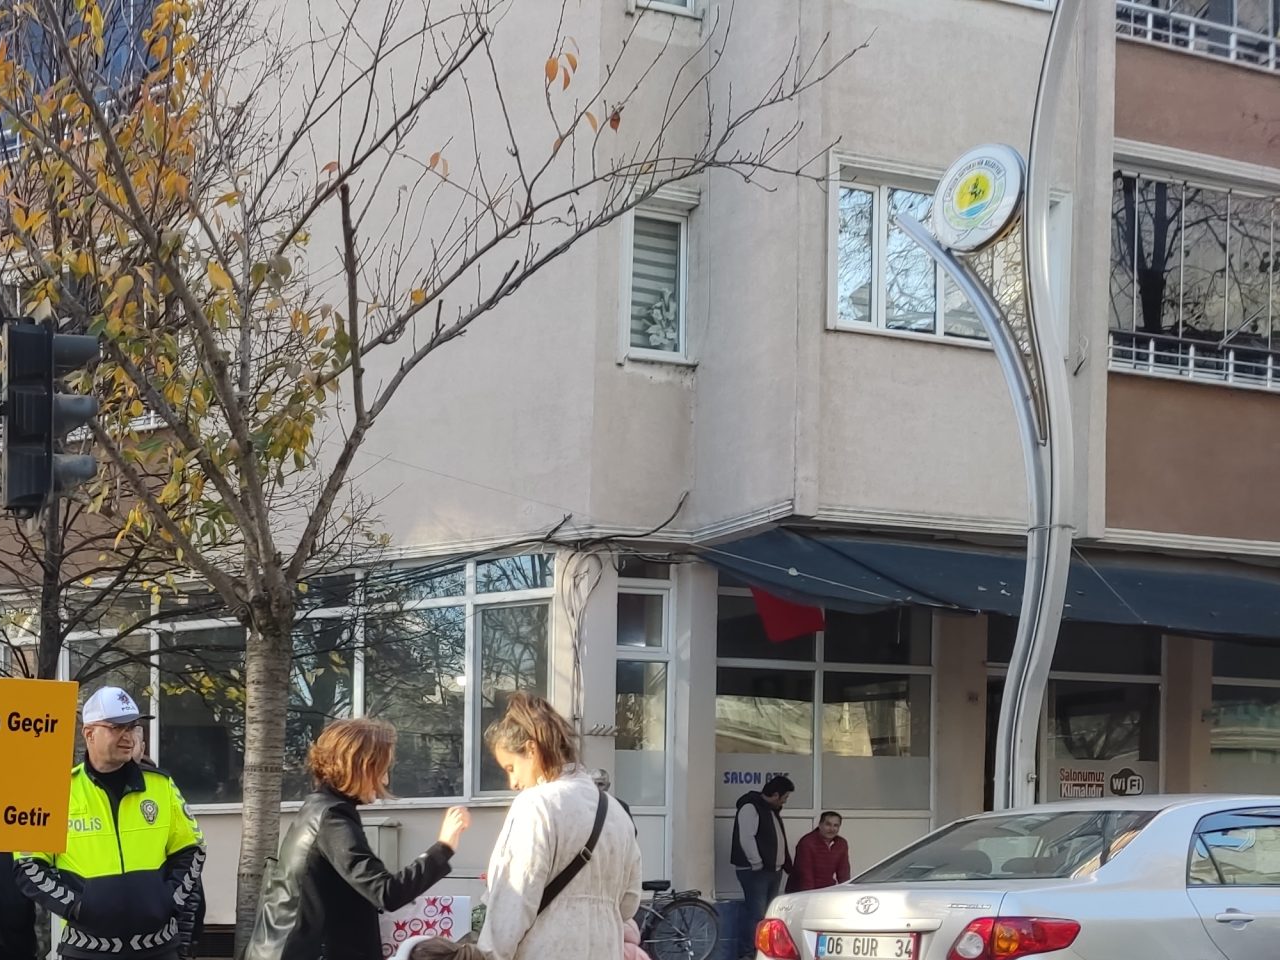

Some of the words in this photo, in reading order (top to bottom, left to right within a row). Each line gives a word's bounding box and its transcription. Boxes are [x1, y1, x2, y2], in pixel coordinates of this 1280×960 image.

[7, 711, 58, 737] Geçir
[723, 771, 762, 784] SALON
[1059, 767, 1105, 782] Salonumuz
[4, 806, 50, 826] Getir
[827, 937, 843, 955] 06
[853, 938, 879, 957] GUR
[895, 939, 913, 958] 34
